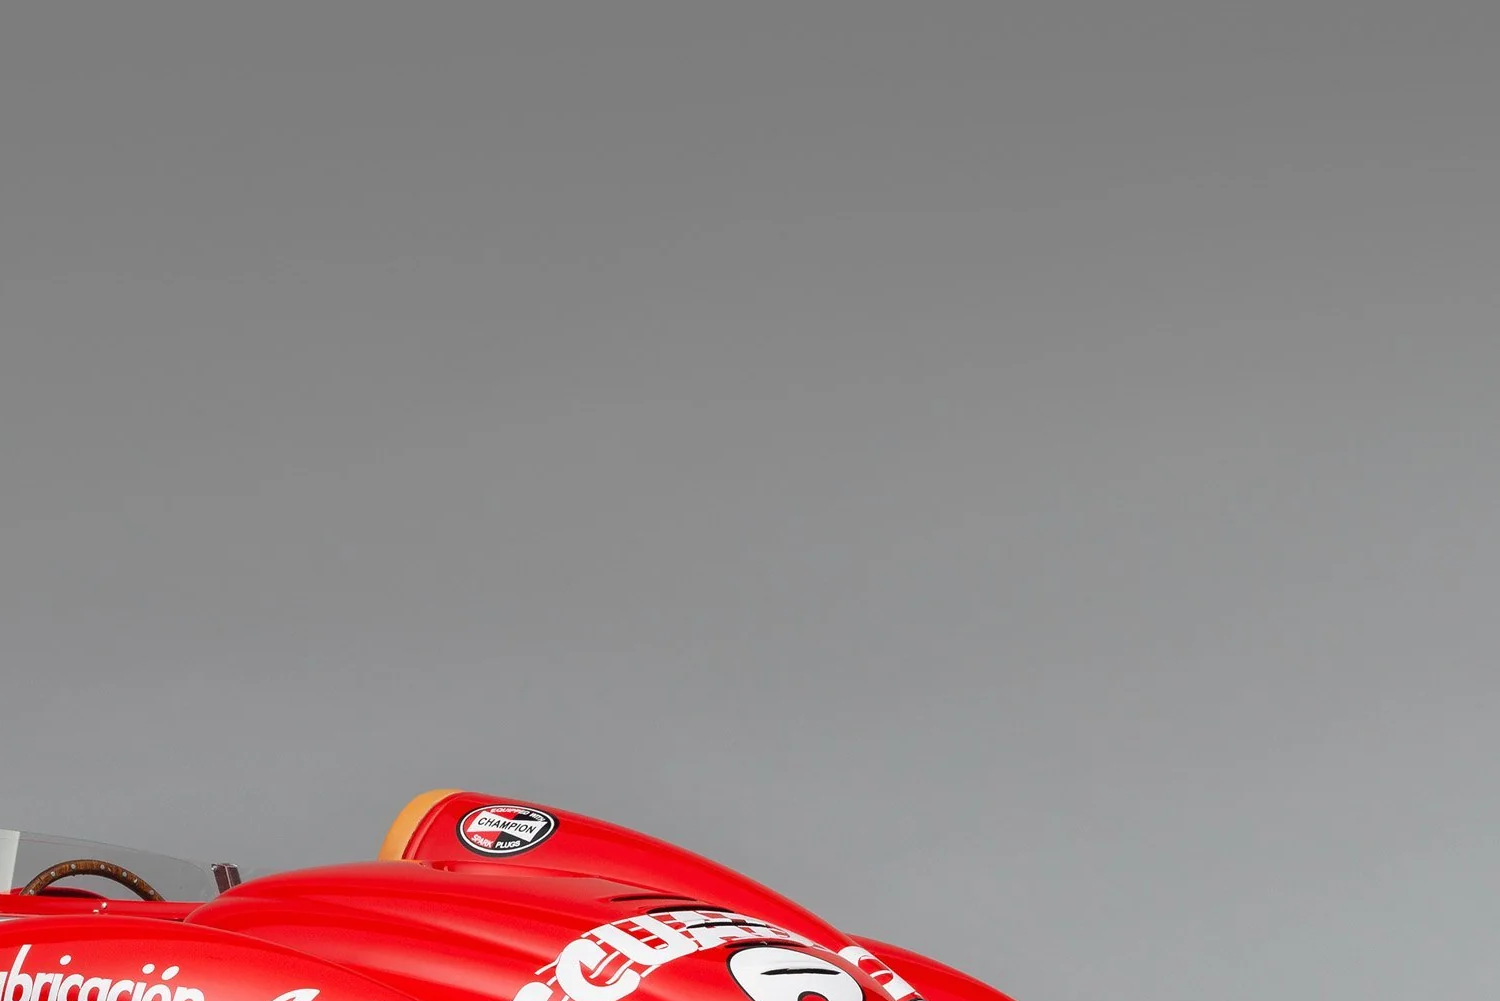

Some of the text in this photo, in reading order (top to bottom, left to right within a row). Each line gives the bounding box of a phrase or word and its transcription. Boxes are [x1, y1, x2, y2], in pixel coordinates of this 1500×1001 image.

[490, 807, 530, 816] EQUIPPED
[477, 817, 537, 834] CHAMPION
[471, 834, 521, 849] SPARK PLUGS
